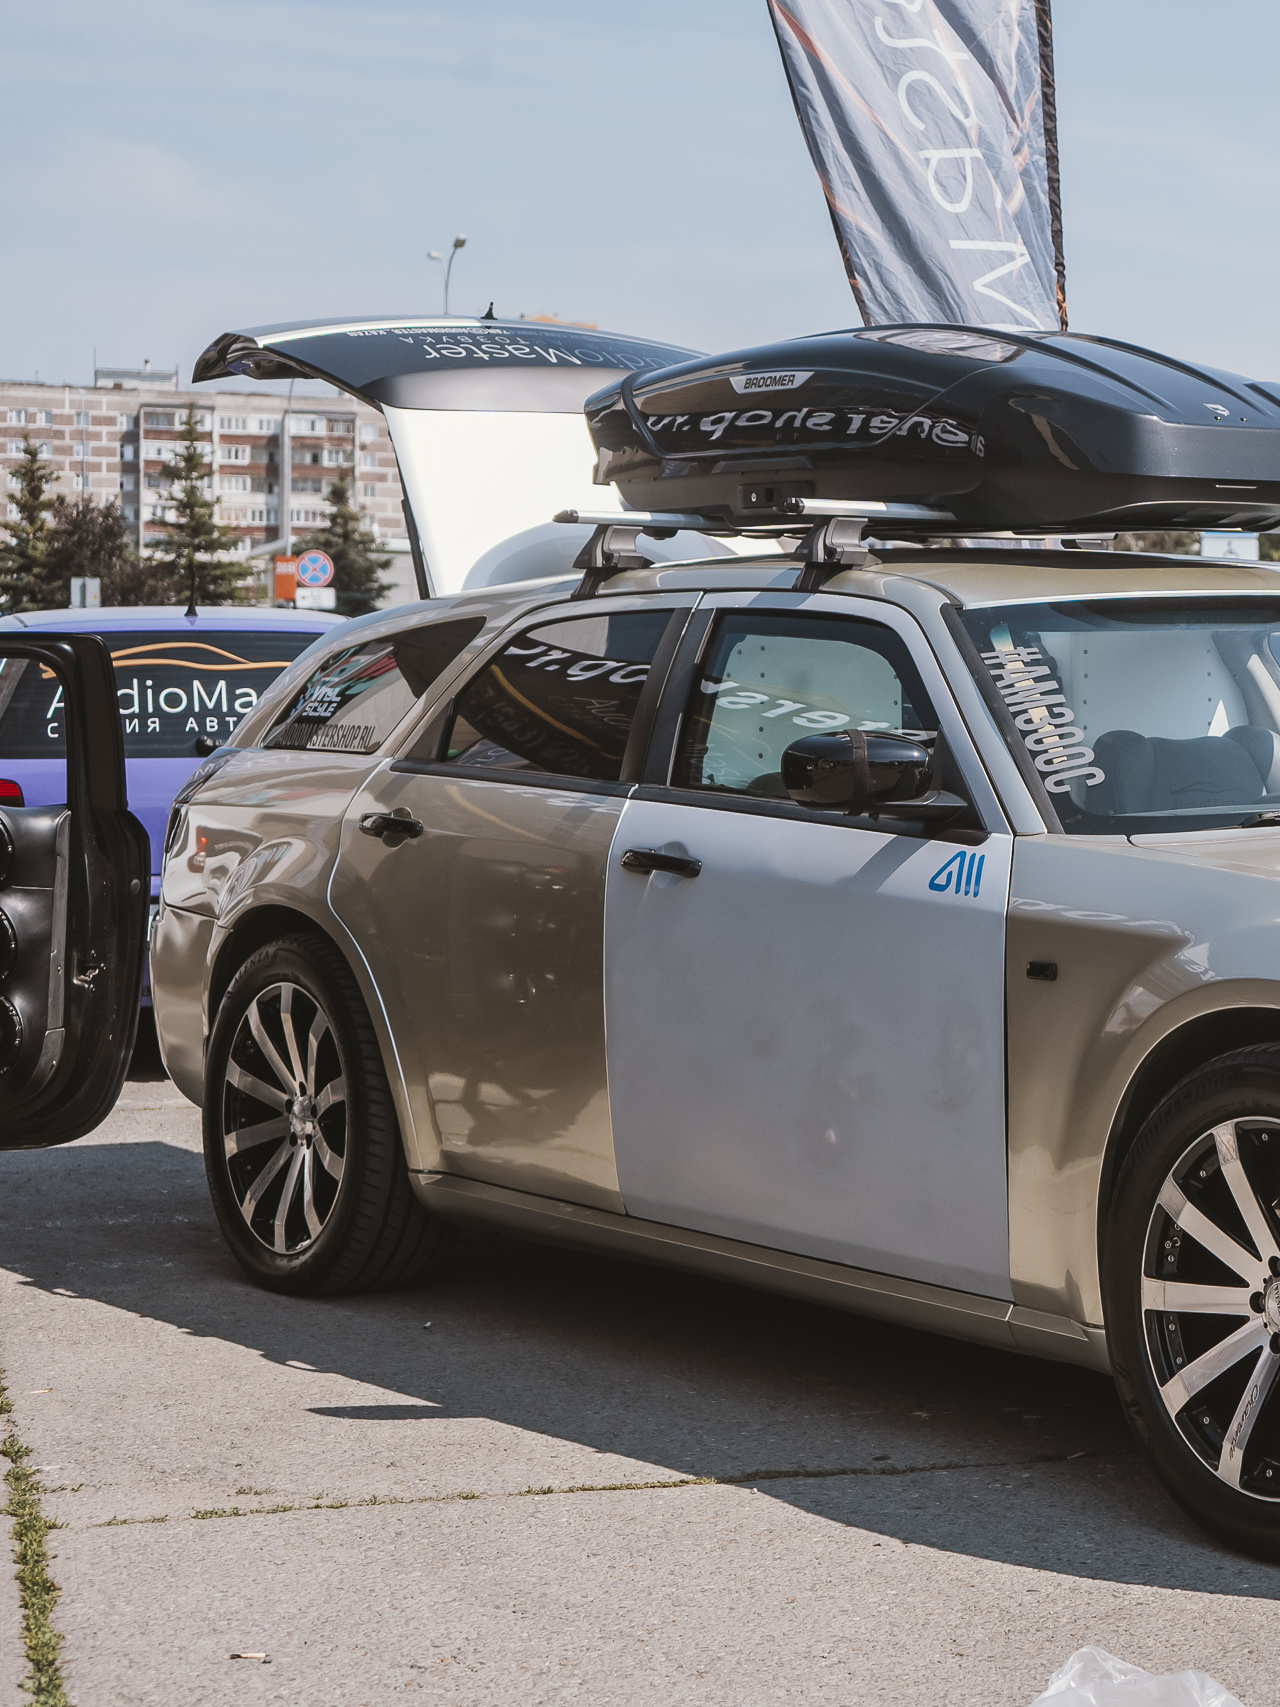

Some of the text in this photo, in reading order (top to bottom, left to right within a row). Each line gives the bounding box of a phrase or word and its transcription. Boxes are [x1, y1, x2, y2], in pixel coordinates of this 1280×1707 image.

[425, 343, 674, 371] udioMaster
[743, 373, 796, 390] BROOMER
[301, 702, 338, 717] STYLE
[185, 716, 239, 733] АВТ
[277, 722, 376, 750] AUDIOMASTERSHOP.RU
